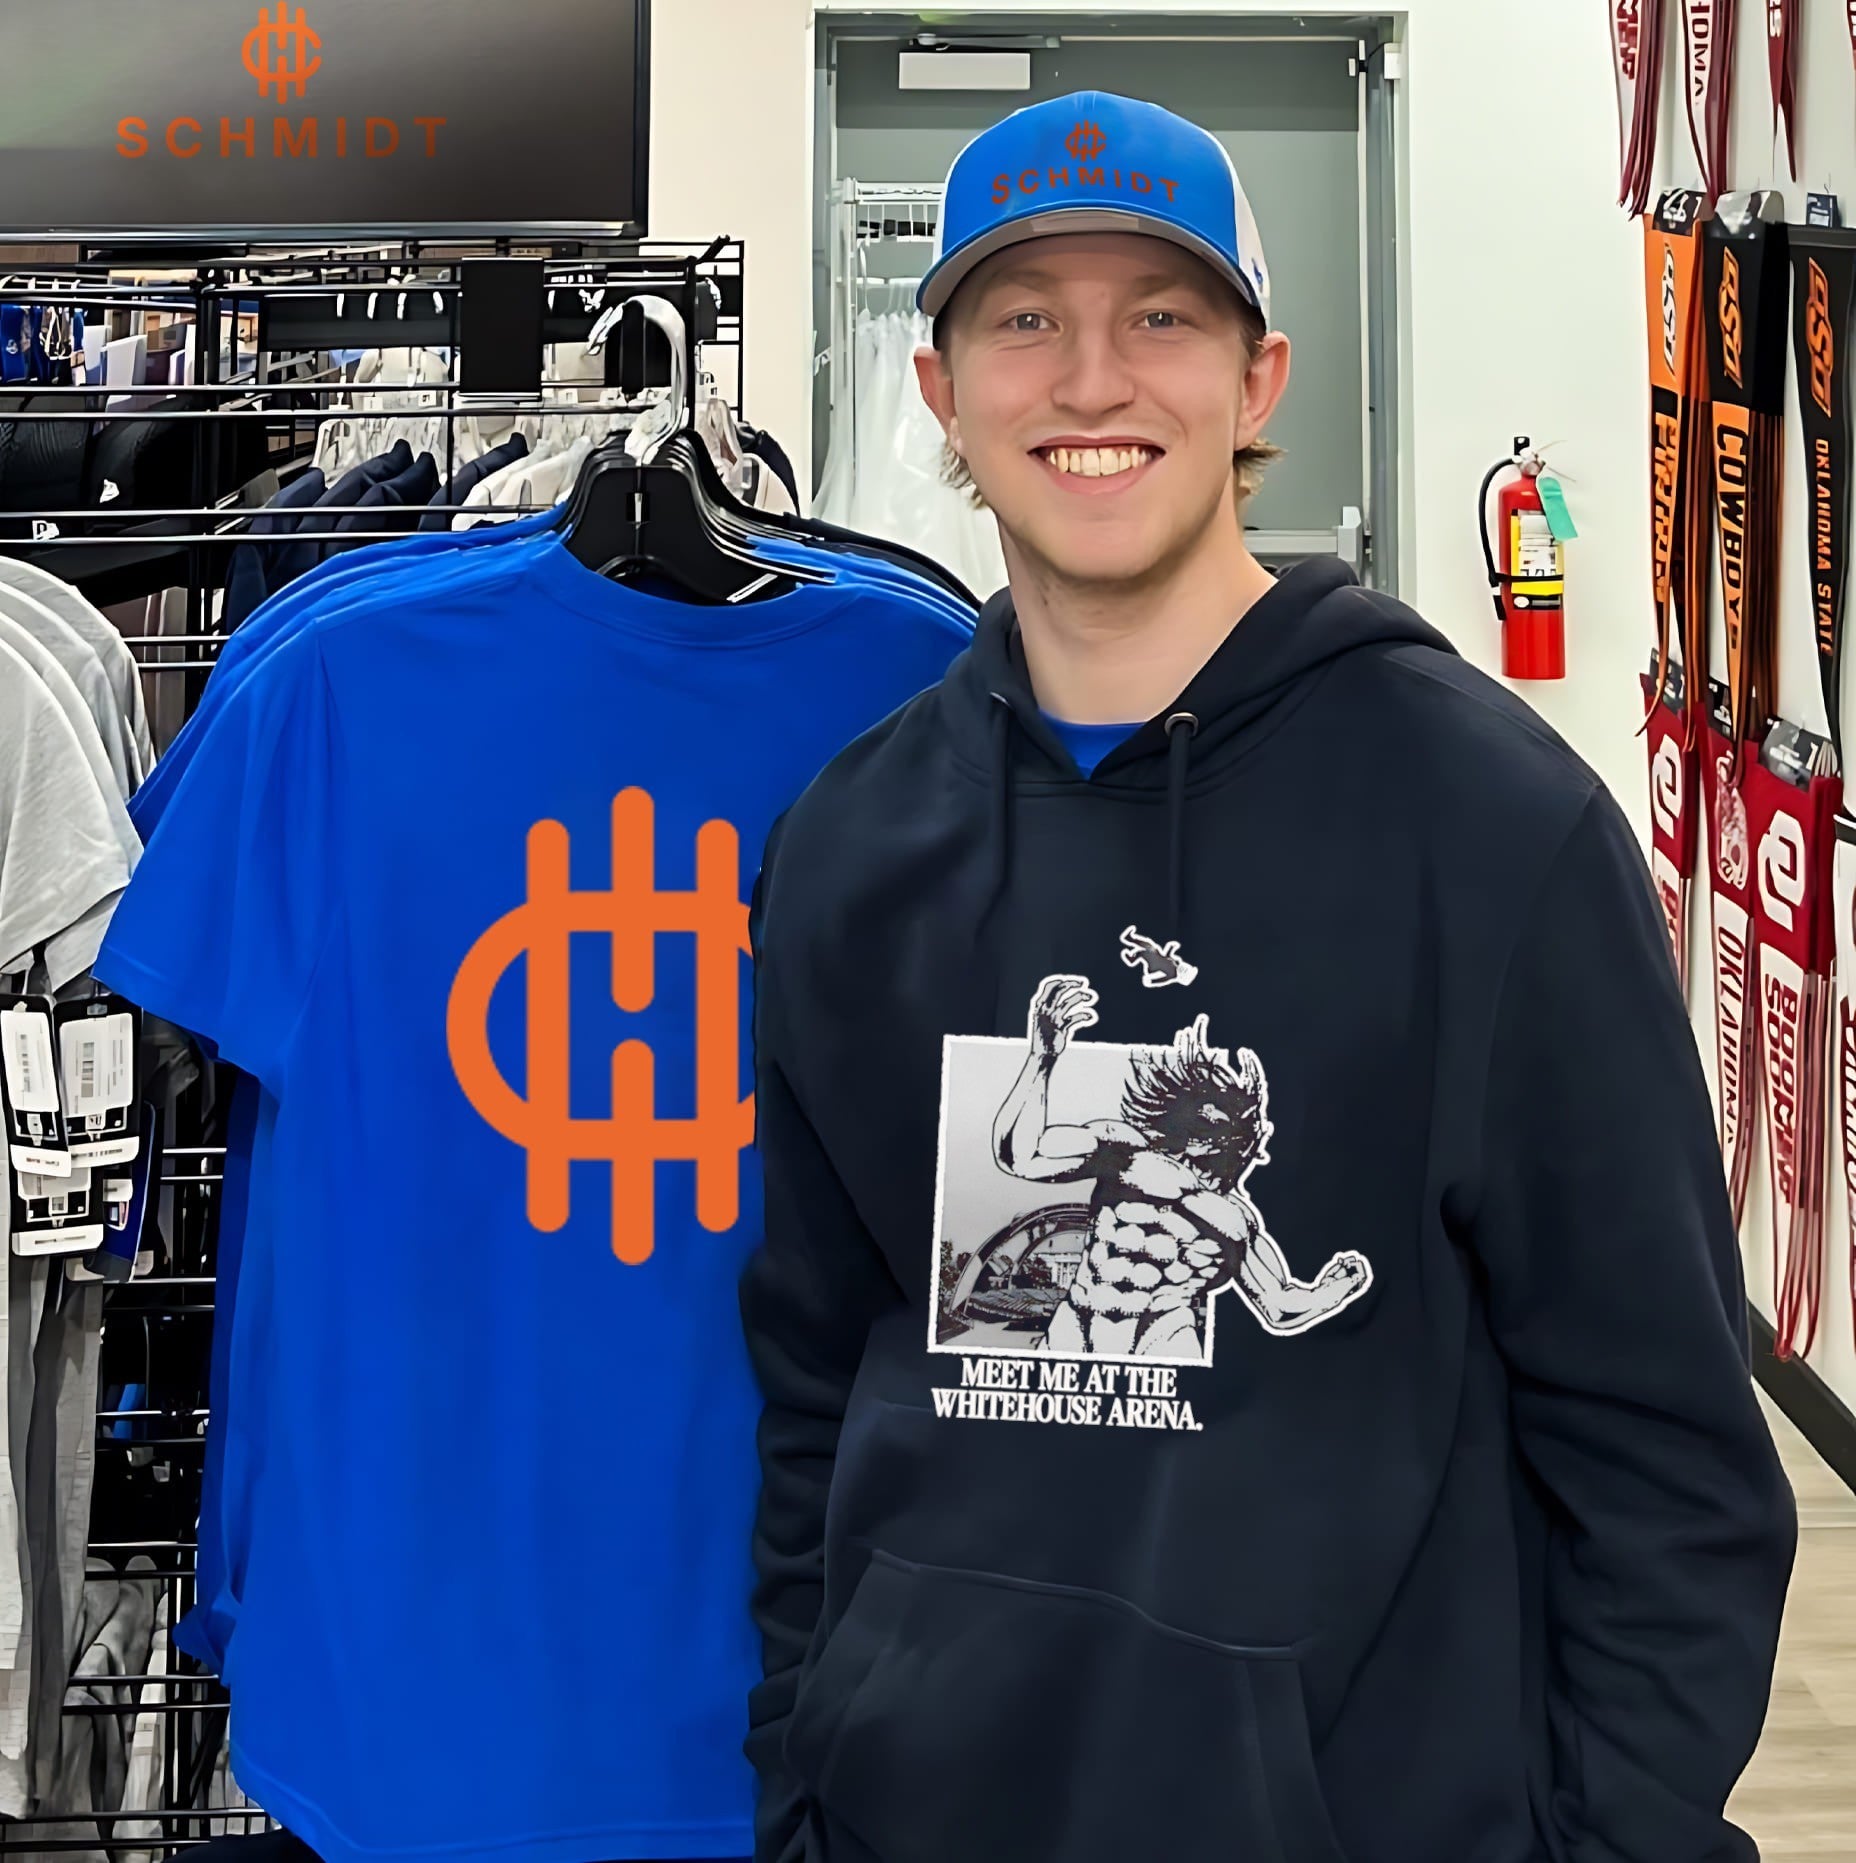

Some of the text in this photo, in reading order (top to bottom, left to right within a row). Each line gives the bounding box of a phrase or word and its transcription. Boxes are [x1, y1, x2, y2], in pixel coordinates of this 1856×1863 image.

[115, 116, 448, 159] SCHMIDT
[991, 166, 1179, 205] SCHMIDT
[1716, 422, 1749, 650] COWBOY
[1814, 439, 1832, 570] OKLAHOMA
[1718, 926, 1746, 1144] OKLAHOMA
[1781, 984, 1799, 1203] BOOM
[930, 1387, 1204, 1432] WHITEHOUSE ARENA.
[960, 1357, 1178, 1398] MEET ME AT THE
